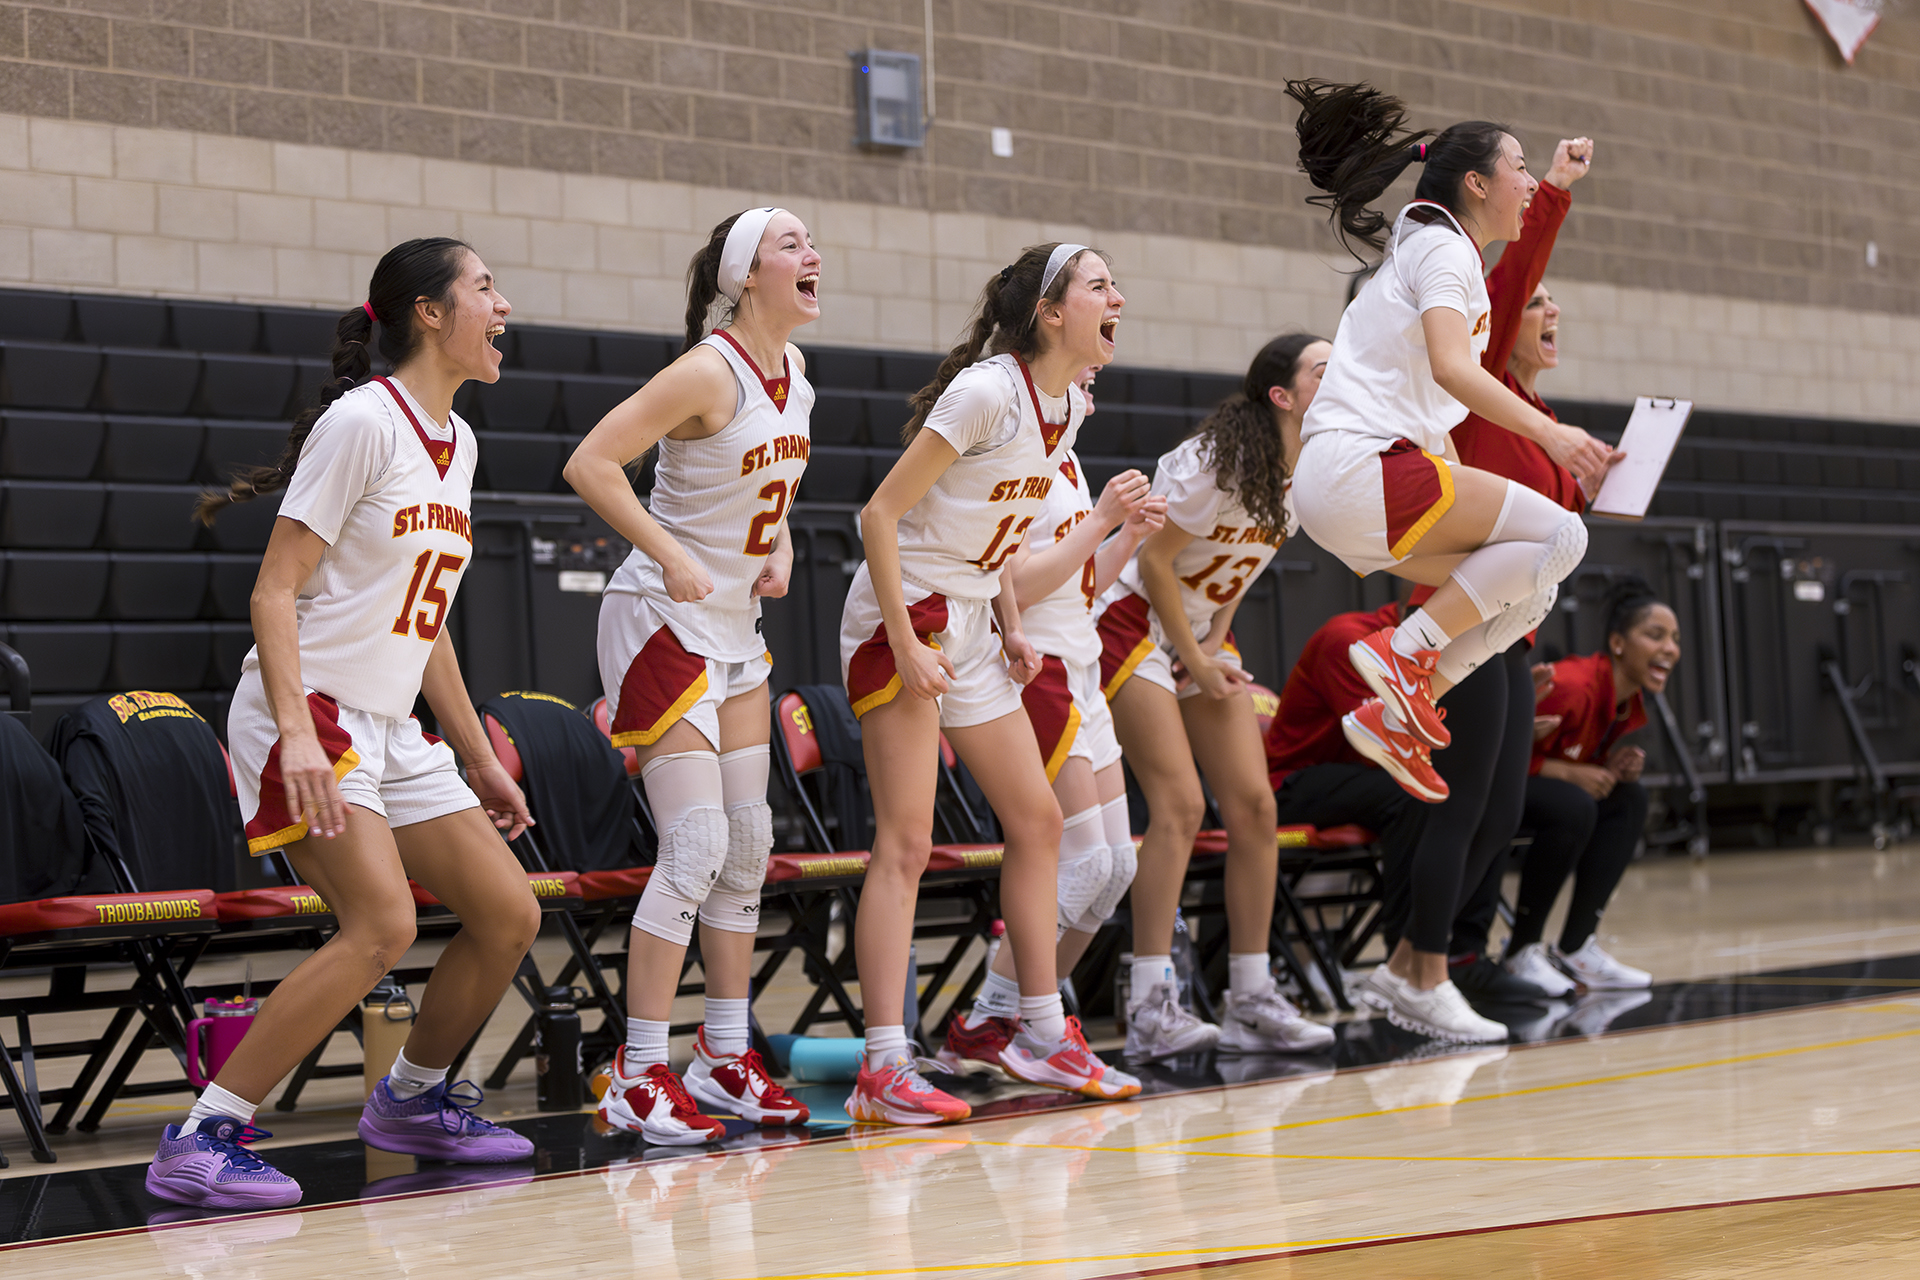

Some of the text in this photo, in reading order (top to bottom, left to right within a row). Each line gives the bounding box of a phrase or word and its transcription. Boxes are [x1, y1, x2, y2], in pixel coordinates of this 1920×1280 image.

[740, 442, 771, 477] ST.
[987, 479, 1022, 502] ST.
[392, 504, 425, 539] ST.
[1206, 525, 1238, 545] ST.
[1180, 554, 1262, 606] 13
[391, 549, 466, 642] 15
[96, 899, 202, 924] TROUBADOURS
[290, 895, 332, 914] TROU
